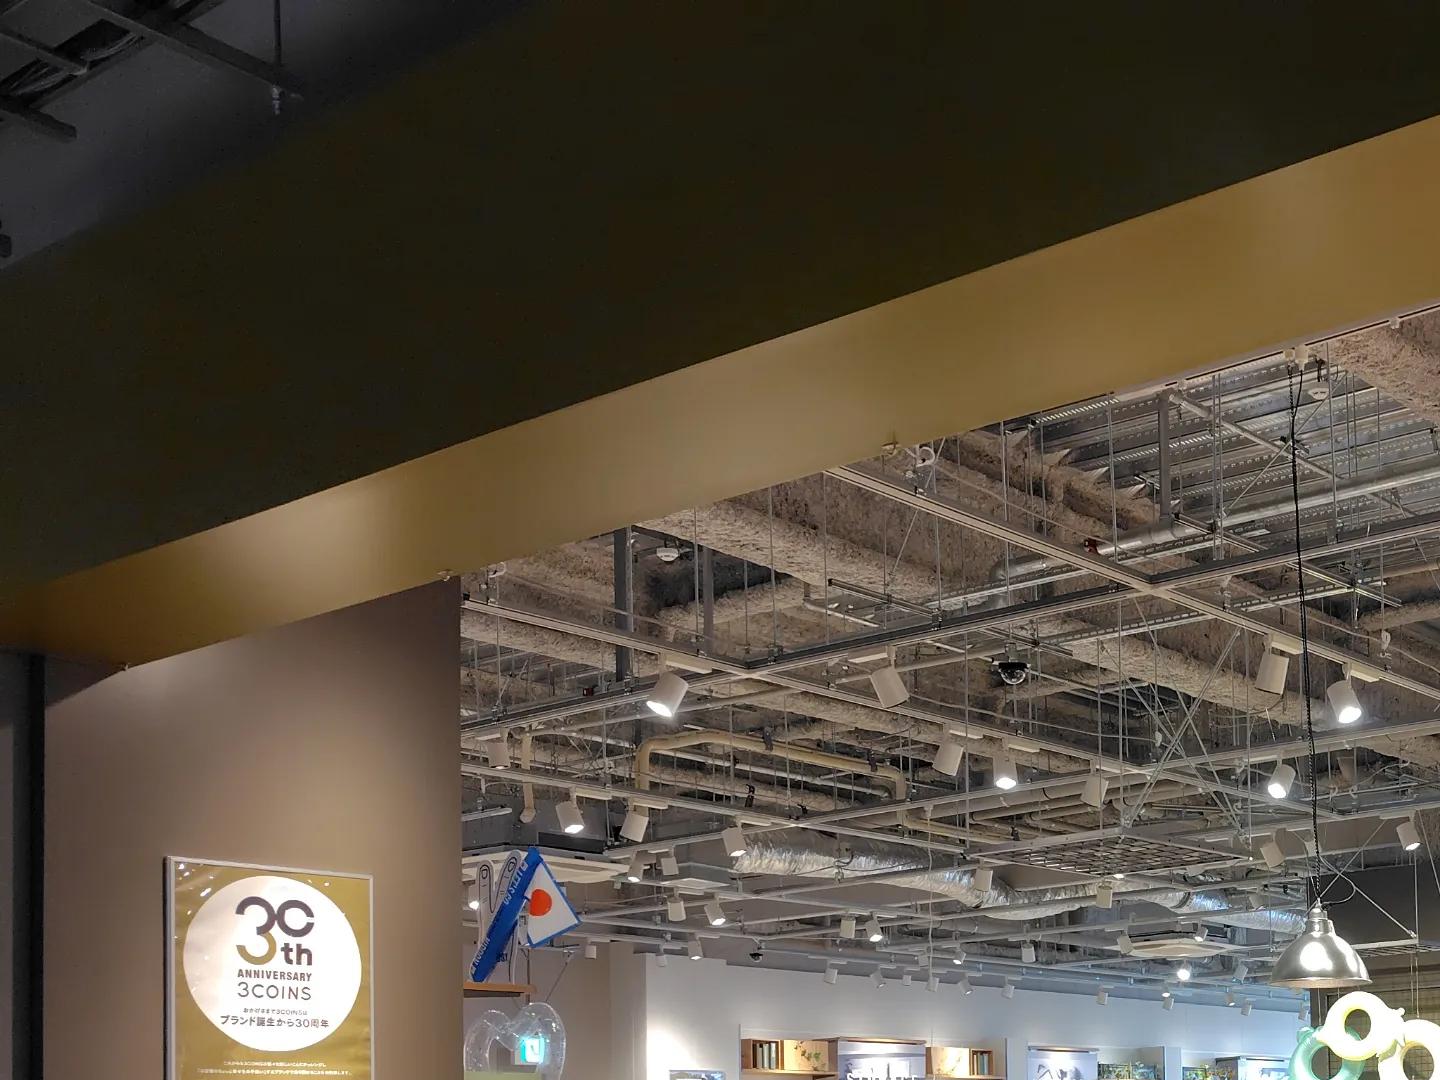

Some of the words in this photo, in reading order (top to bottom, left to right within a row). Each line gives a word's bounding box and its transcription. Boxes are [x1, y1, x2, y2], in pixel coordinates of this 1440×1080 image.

[237, 968, 313, 982] ANNIVERSARY
[237, 981, 312, 1001] 3COINS
[220, 1014, 330, 1029] ブランド誕生から30周年
